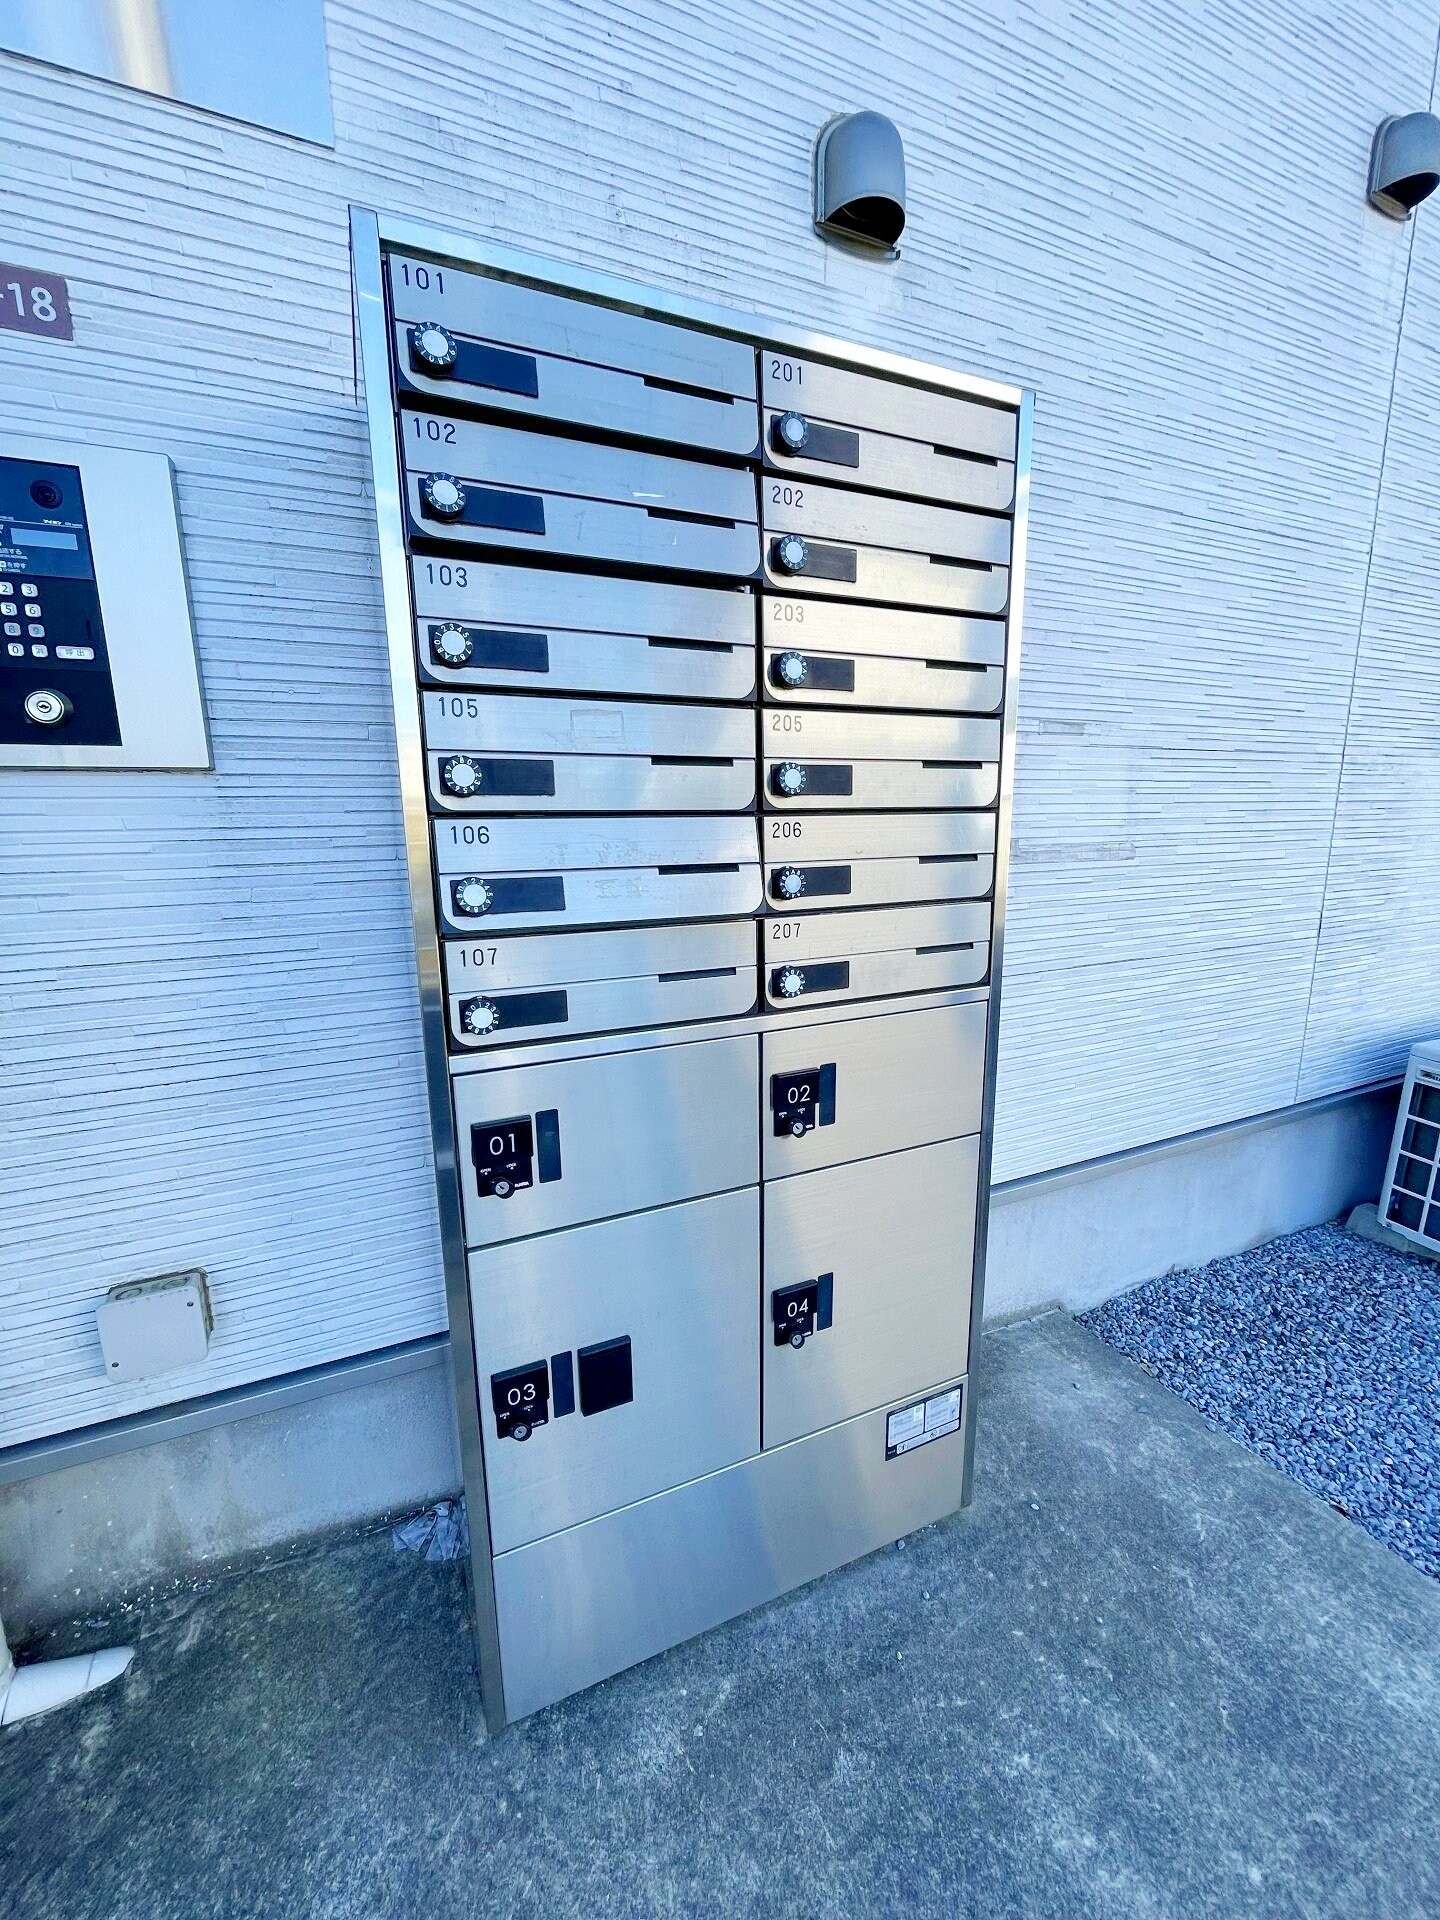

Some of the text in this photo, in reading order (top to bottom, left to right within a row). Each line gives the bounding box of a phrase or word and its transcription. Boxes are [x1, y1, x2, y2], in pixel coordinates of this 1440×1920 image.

[401, 263, 444, 295] 101
[772, 360, 803, 385] 201
[413, 417, 457, 445] 102
[772, 485, 804, 508] 202
[426, 563, 468, 588] 103
[1, 585, 8, 593] 2
[26, 586, 33, 594] 3
[5, 605, 12, 613] 5
[29, 607, 36, 615] 6
[773, 602, 804, 623] 203
[12, 646, 19, 654] 0
[438, 697, 478, 719] 105
[772, 714, 802, 733] 205
[450, 825, 490, 845] 106
[772, 822, 802, 838] 206
[772, 923, 801, 940] 207
[460, 947, 497, 967] 107
[788, 1085, 810, 1104] 02
[489, 1133, 515, 1155] 01
[788, 1298, 809, 1317] 04
[507, 1384, 536, 1406] 03
